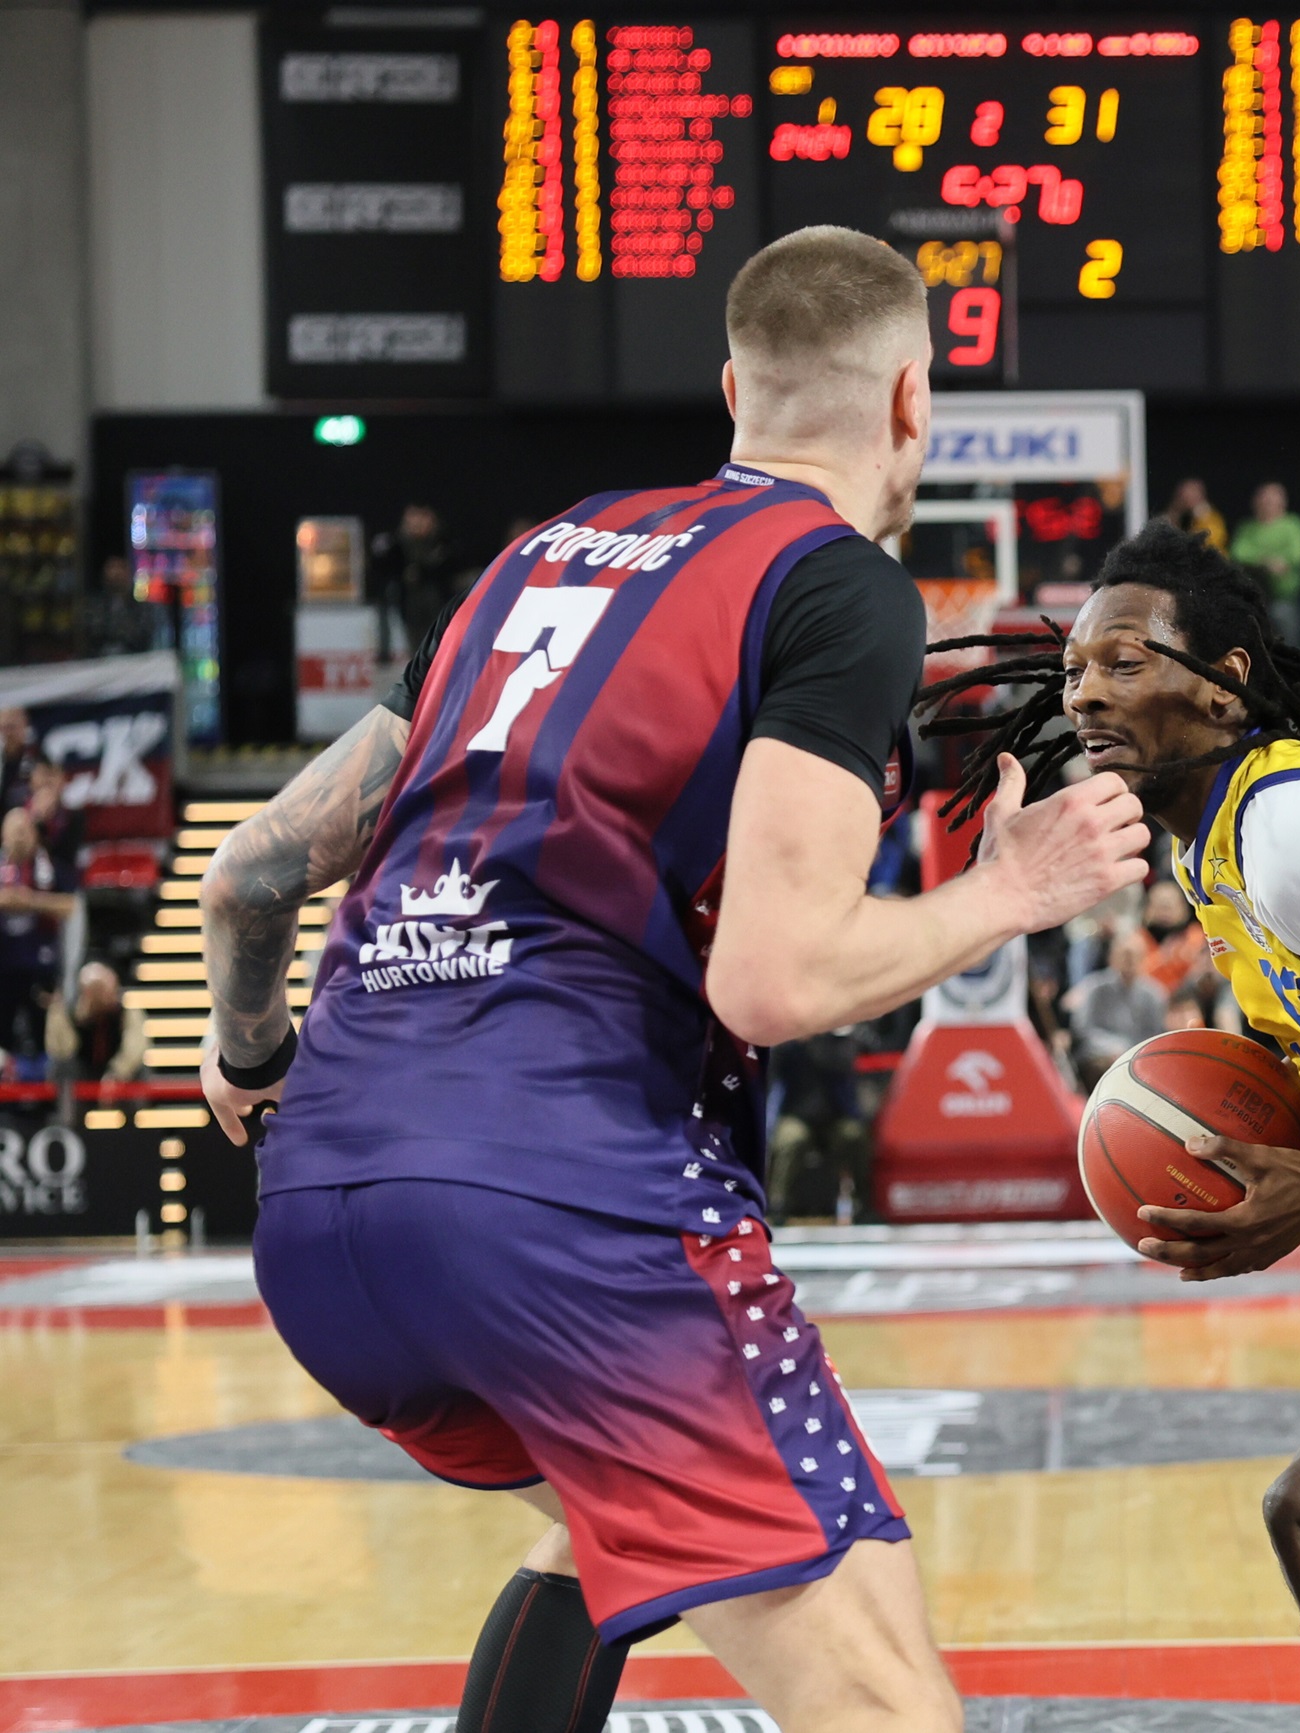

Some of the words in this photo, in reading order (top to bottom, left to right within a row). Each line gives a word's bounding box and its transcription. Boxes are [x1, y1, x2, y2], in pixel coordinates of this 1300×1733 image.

[1078, 239, 1123, 299] 2
[947, 287, 1002, 366] 9
[924, 428, 1079, 463] UZUKI
[519, 522, 705, 572] POPOVIĆ
[465, 586, 616, 753] 7
[361, 955, 505, 994] HURTOWNIE
[1219, 1099, 1265, 1136] APPROVED
[1226, 1080, 1277, 1127] FIBA
[1165, 1164, 1219, 1207] COMPETITION
